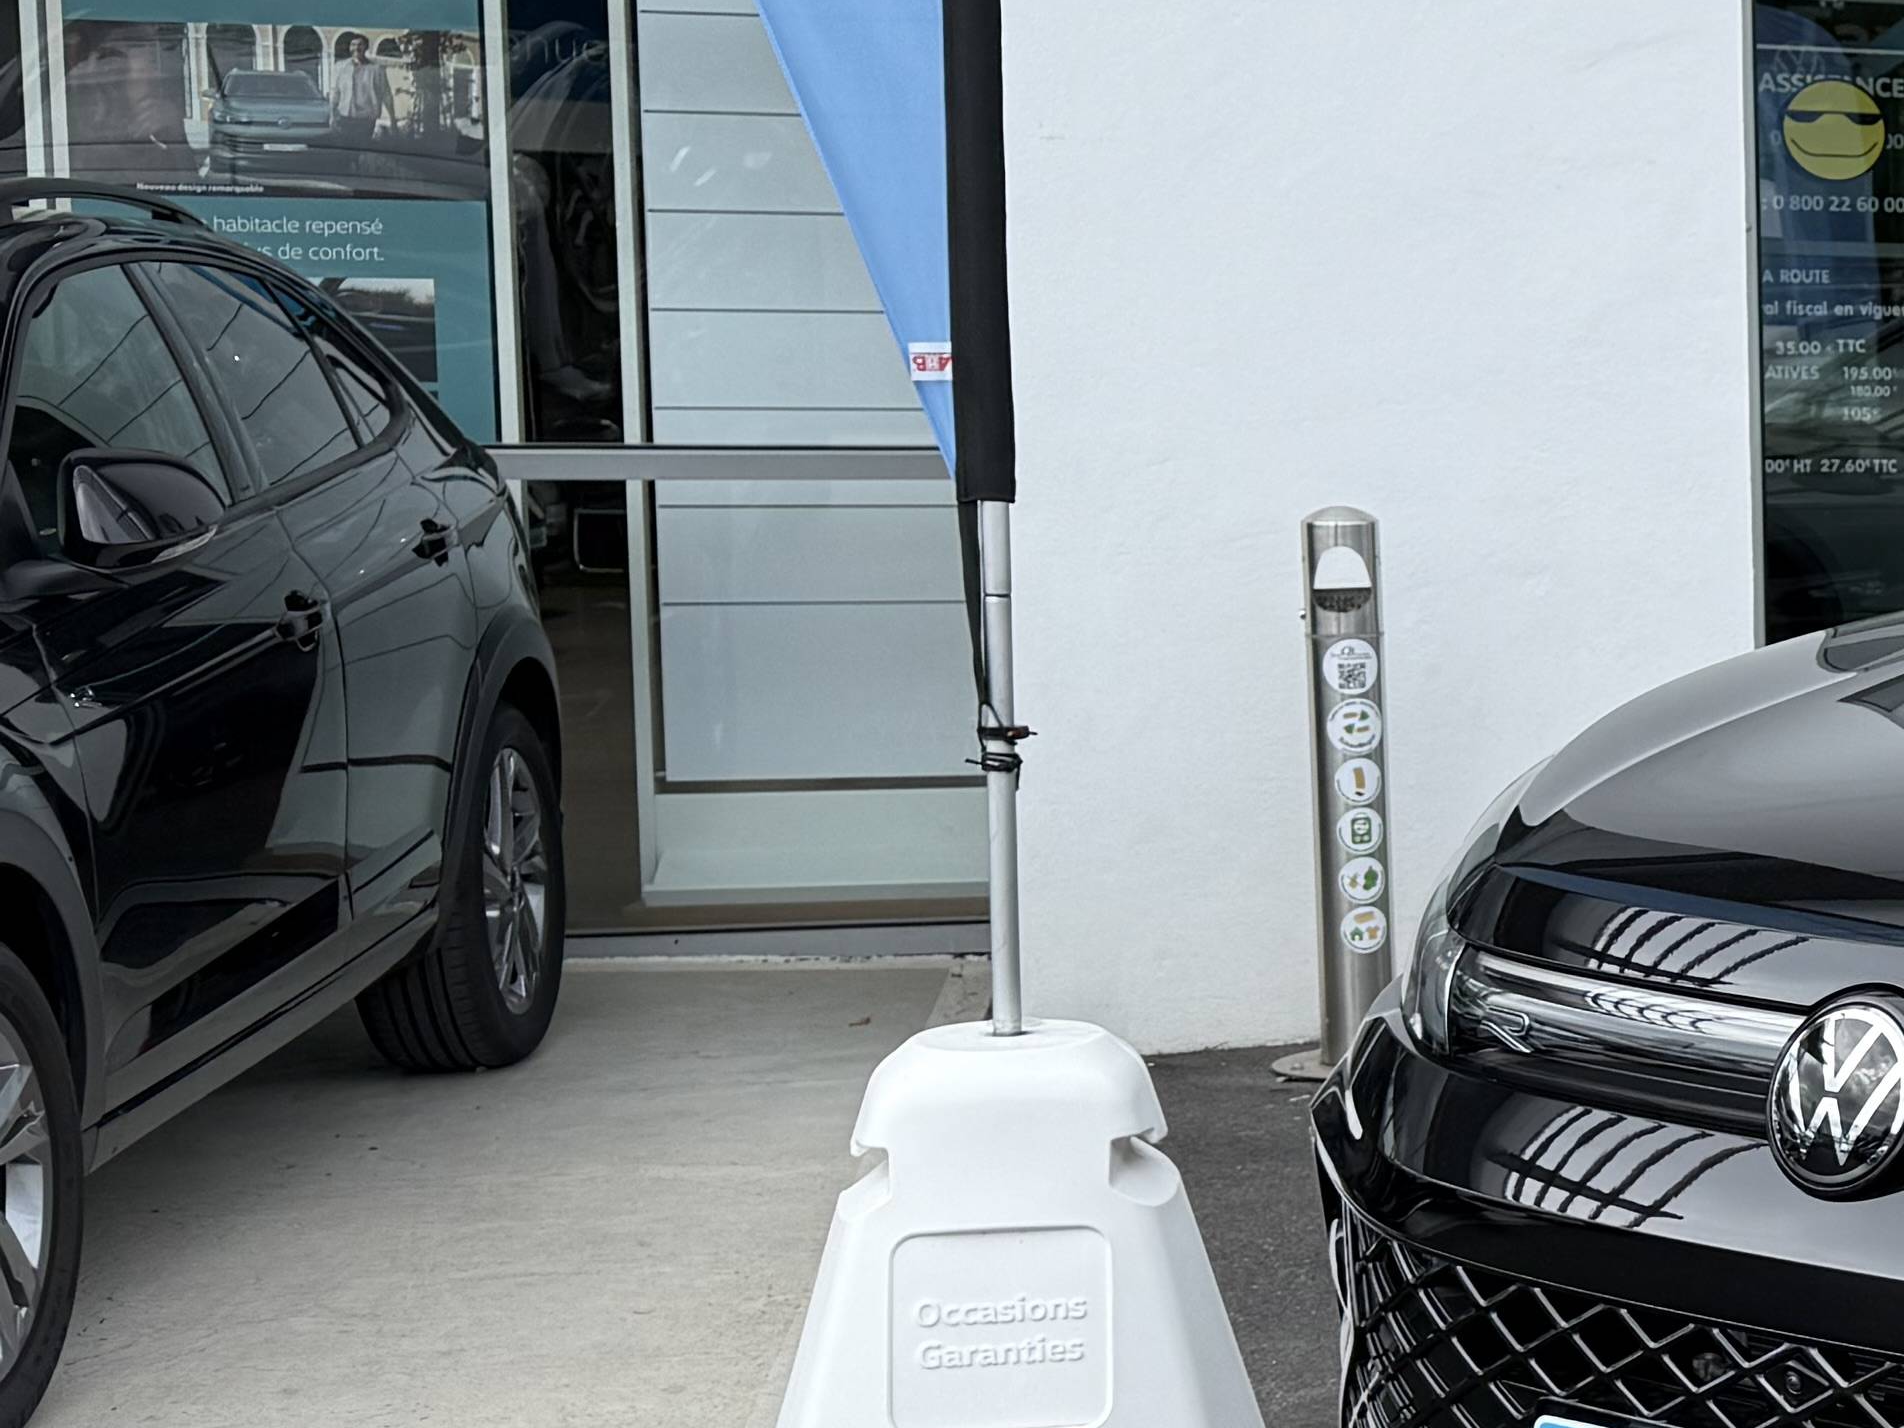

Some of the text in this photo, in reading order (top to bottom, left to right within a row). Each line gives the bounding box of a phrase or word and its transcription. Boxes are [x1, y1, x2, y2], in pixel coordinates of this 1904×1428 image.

[1789, 195, 1824, 211] 800
[1828, 196, 1851, 212] 22
[1856, 197, 1879, 213] 60
[213, 215, 383, 236] habitacle repensé
[277, 243, 302, 259] de
[308, 243, 385, 261] confort.
[1779, 269, 1831, 284] ROUTE
[1785, 300, 1828, 316] fiscal
[1834, 303, 1854, 316] en
[1835, 339, 1867, 353] TTC
[911, 1294, 1089, 1330] Occasions
[918, 1335, 1087, 1372] Garanties
